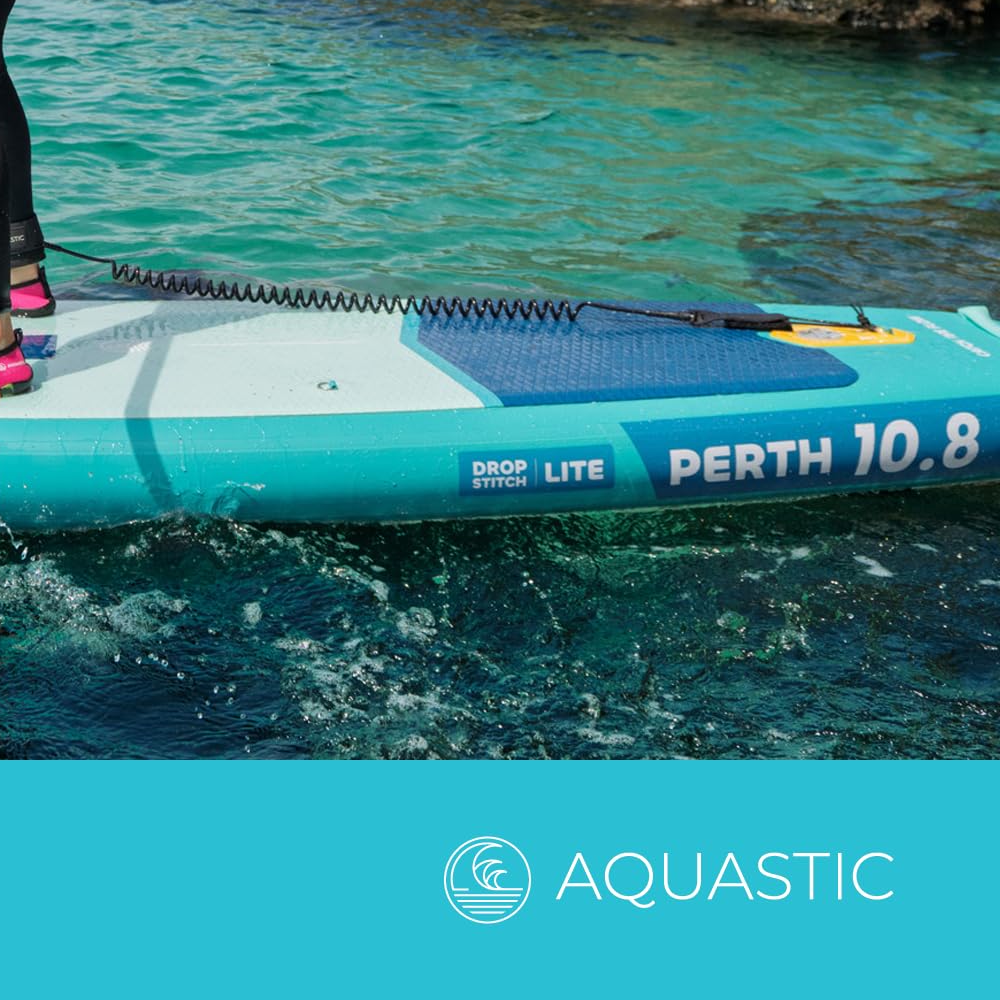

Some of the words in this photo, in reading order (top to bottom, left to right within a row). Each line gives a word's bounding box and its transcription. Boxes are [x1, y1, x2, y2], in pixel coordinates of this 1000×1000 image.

[669, 437, 832, 486] PERTH
[854, 411, 980, 476] 10.8
[472, 459, 528, 476] DROP
[544, 459, 604, 483] LITE
[472, 476, 527, 489] STITCH
